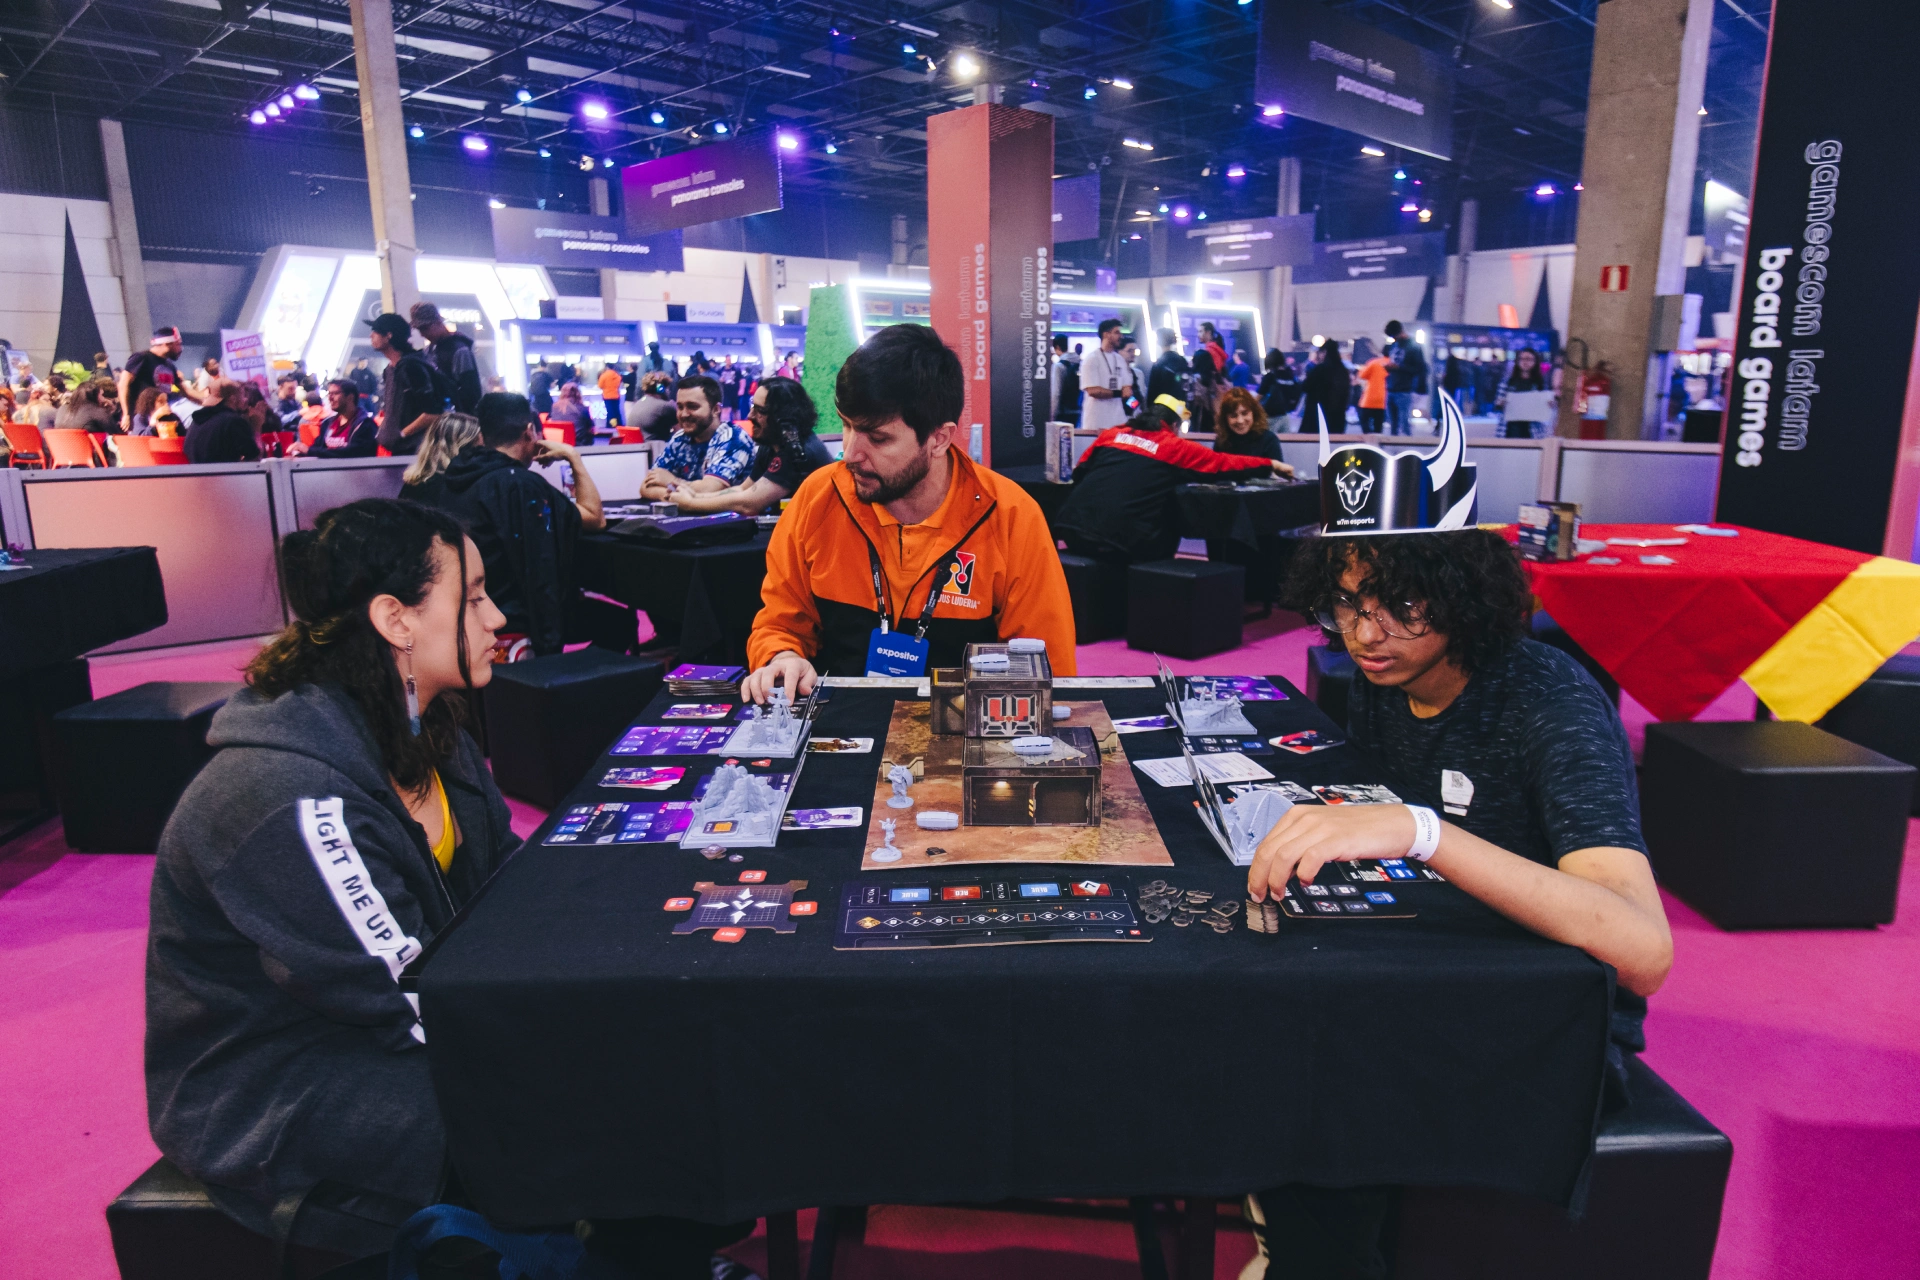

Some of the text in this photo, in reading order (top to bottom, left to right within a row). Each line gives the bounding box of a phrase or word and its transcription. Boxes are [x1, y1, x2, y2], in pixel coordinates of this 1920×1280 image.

[562, 240, 611, 251] panorama
[1777, 140, 1843, 451] gamescom latam
[973, 243, 989, 381] board games
[1020, 256, 1036, 438] gamescom latam
[1034, 247, 1050, 380] board games
[1735, 247, 1794, 467] board games
[1113, 432, 1159, 455] MONITORIA
[1350, 516, 1375, 526] esports
[876, 646, 919, 662] expositor
[342, 874, 374, 912] ME
[365, 913, 394, 943] UP
